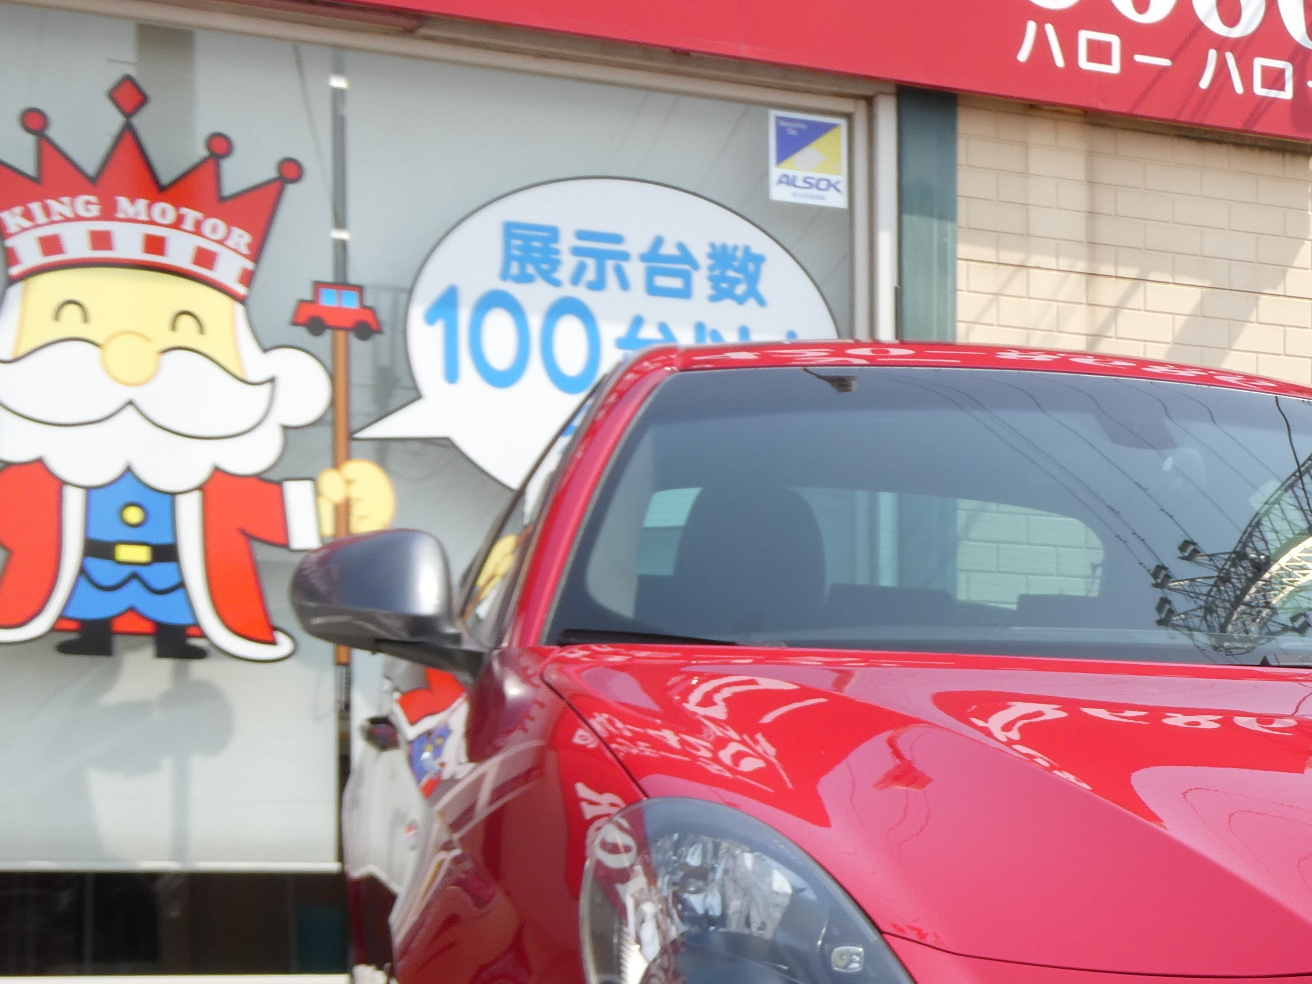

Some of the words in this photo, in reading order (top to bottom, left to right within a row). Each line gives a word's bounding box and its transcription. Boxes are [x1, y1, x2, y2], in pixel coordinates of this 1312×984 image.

[1016, 20, 1172, 74] ハロー
[777, 173, 842, 194] ALSOK
[0, 194, 102, 234] KING
[114, 196, 254, 256] MOTOR
[500, 220, 768, 308] 展示台数
